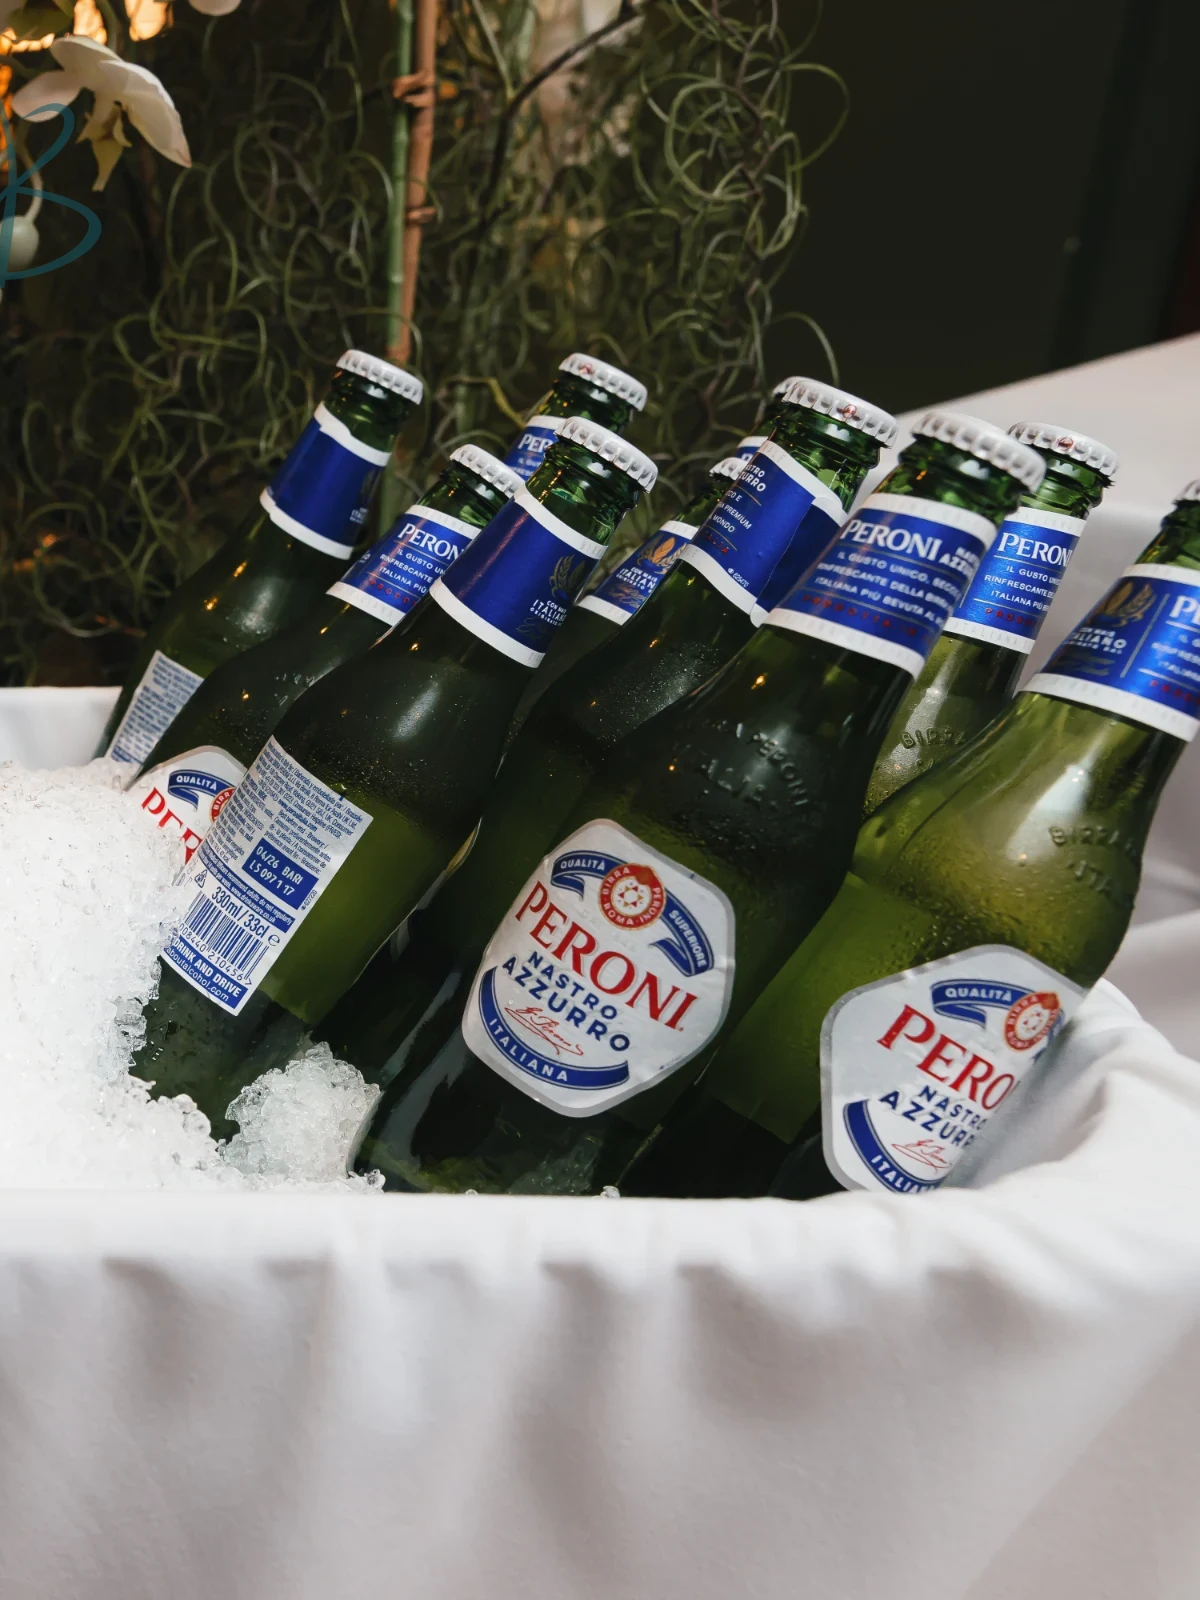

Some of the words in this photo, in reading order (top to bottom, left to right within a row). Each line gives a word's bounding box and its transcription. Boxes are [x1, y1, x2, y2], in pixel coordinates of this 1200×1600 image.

[517, 433, 553, 453] PER
[713, 515, 735, 533] MONDO
[724, 504, 752, 529] PREMIUM
[398, 522, 464, 561] PERON
[840, 519, 943, 562] PERONI
[380, 554, 433, 583] RINFRESCANTE
[405, 552, 433, 570] GUSTO
[630, 566, 643, 576] CON
[848, 552, 888, 570] GUSTO
[1006, 565, 1014, 573] IL
[1018, 568, 1049, 582] GUSTO
[380, 566, 412, 587] ITALIANA
[413, 582, 427, 594] PIÙ
[620, 568, 657, 588] ITALIAN
[814, 577, 858, 595] ITALIANA
[817, 562, 887, 587] RINFRESCANTE
[889, 580, 923, 598] DELLA
[984, 574, 1048, 597] RINFRESCANTE
[991, 589, 1031, 606] ITALIANA
[176, 774, 218, 791] QUALITÀ
[213, 788, 234, 811] BIRR
[249, 861, 261, 874] L5
[258, 867, 279, 886] 097
[276, 878, 284, 890] 1
[283, 884, 296, 897] 17
[254, 845, 279, 869] 04/26
[281, 865, 304, 886] BARI
[245, 888, 261, 902] adults
[258, 897, 266, 906] do
[264, 902, 274, 912] not
[271, 907, 293, 926] regularly
[602, 866, 630, 895] BIRRA
[640, 887, 661, 923] PERONI
[211, 885, 243, 921] 330ml
[243, 913, 271, 939] 33cl
[560, 859, 605, 871] QUALITÀ
[668, 909, 707, 967] SUPERIORE
[603, 902, 634, 926] ROMA
[171, 935, 196, 963] DRINK
[194, 958, 214, 980] AND
[213, 971, 242, 999] DRIVE
[207, 950, 243, 982] 210456
[515, 881, 698, 1032] PERONI
[528, 951, 618, 1020] NASTRO
[945, 987, 1012, 1001] QUALITÀ
[502, 956, 631, 1051] AZZURRO
[489, 1018, 569, 1082] ITALIANA
[877, 1004, 1014, 1111] PERO
